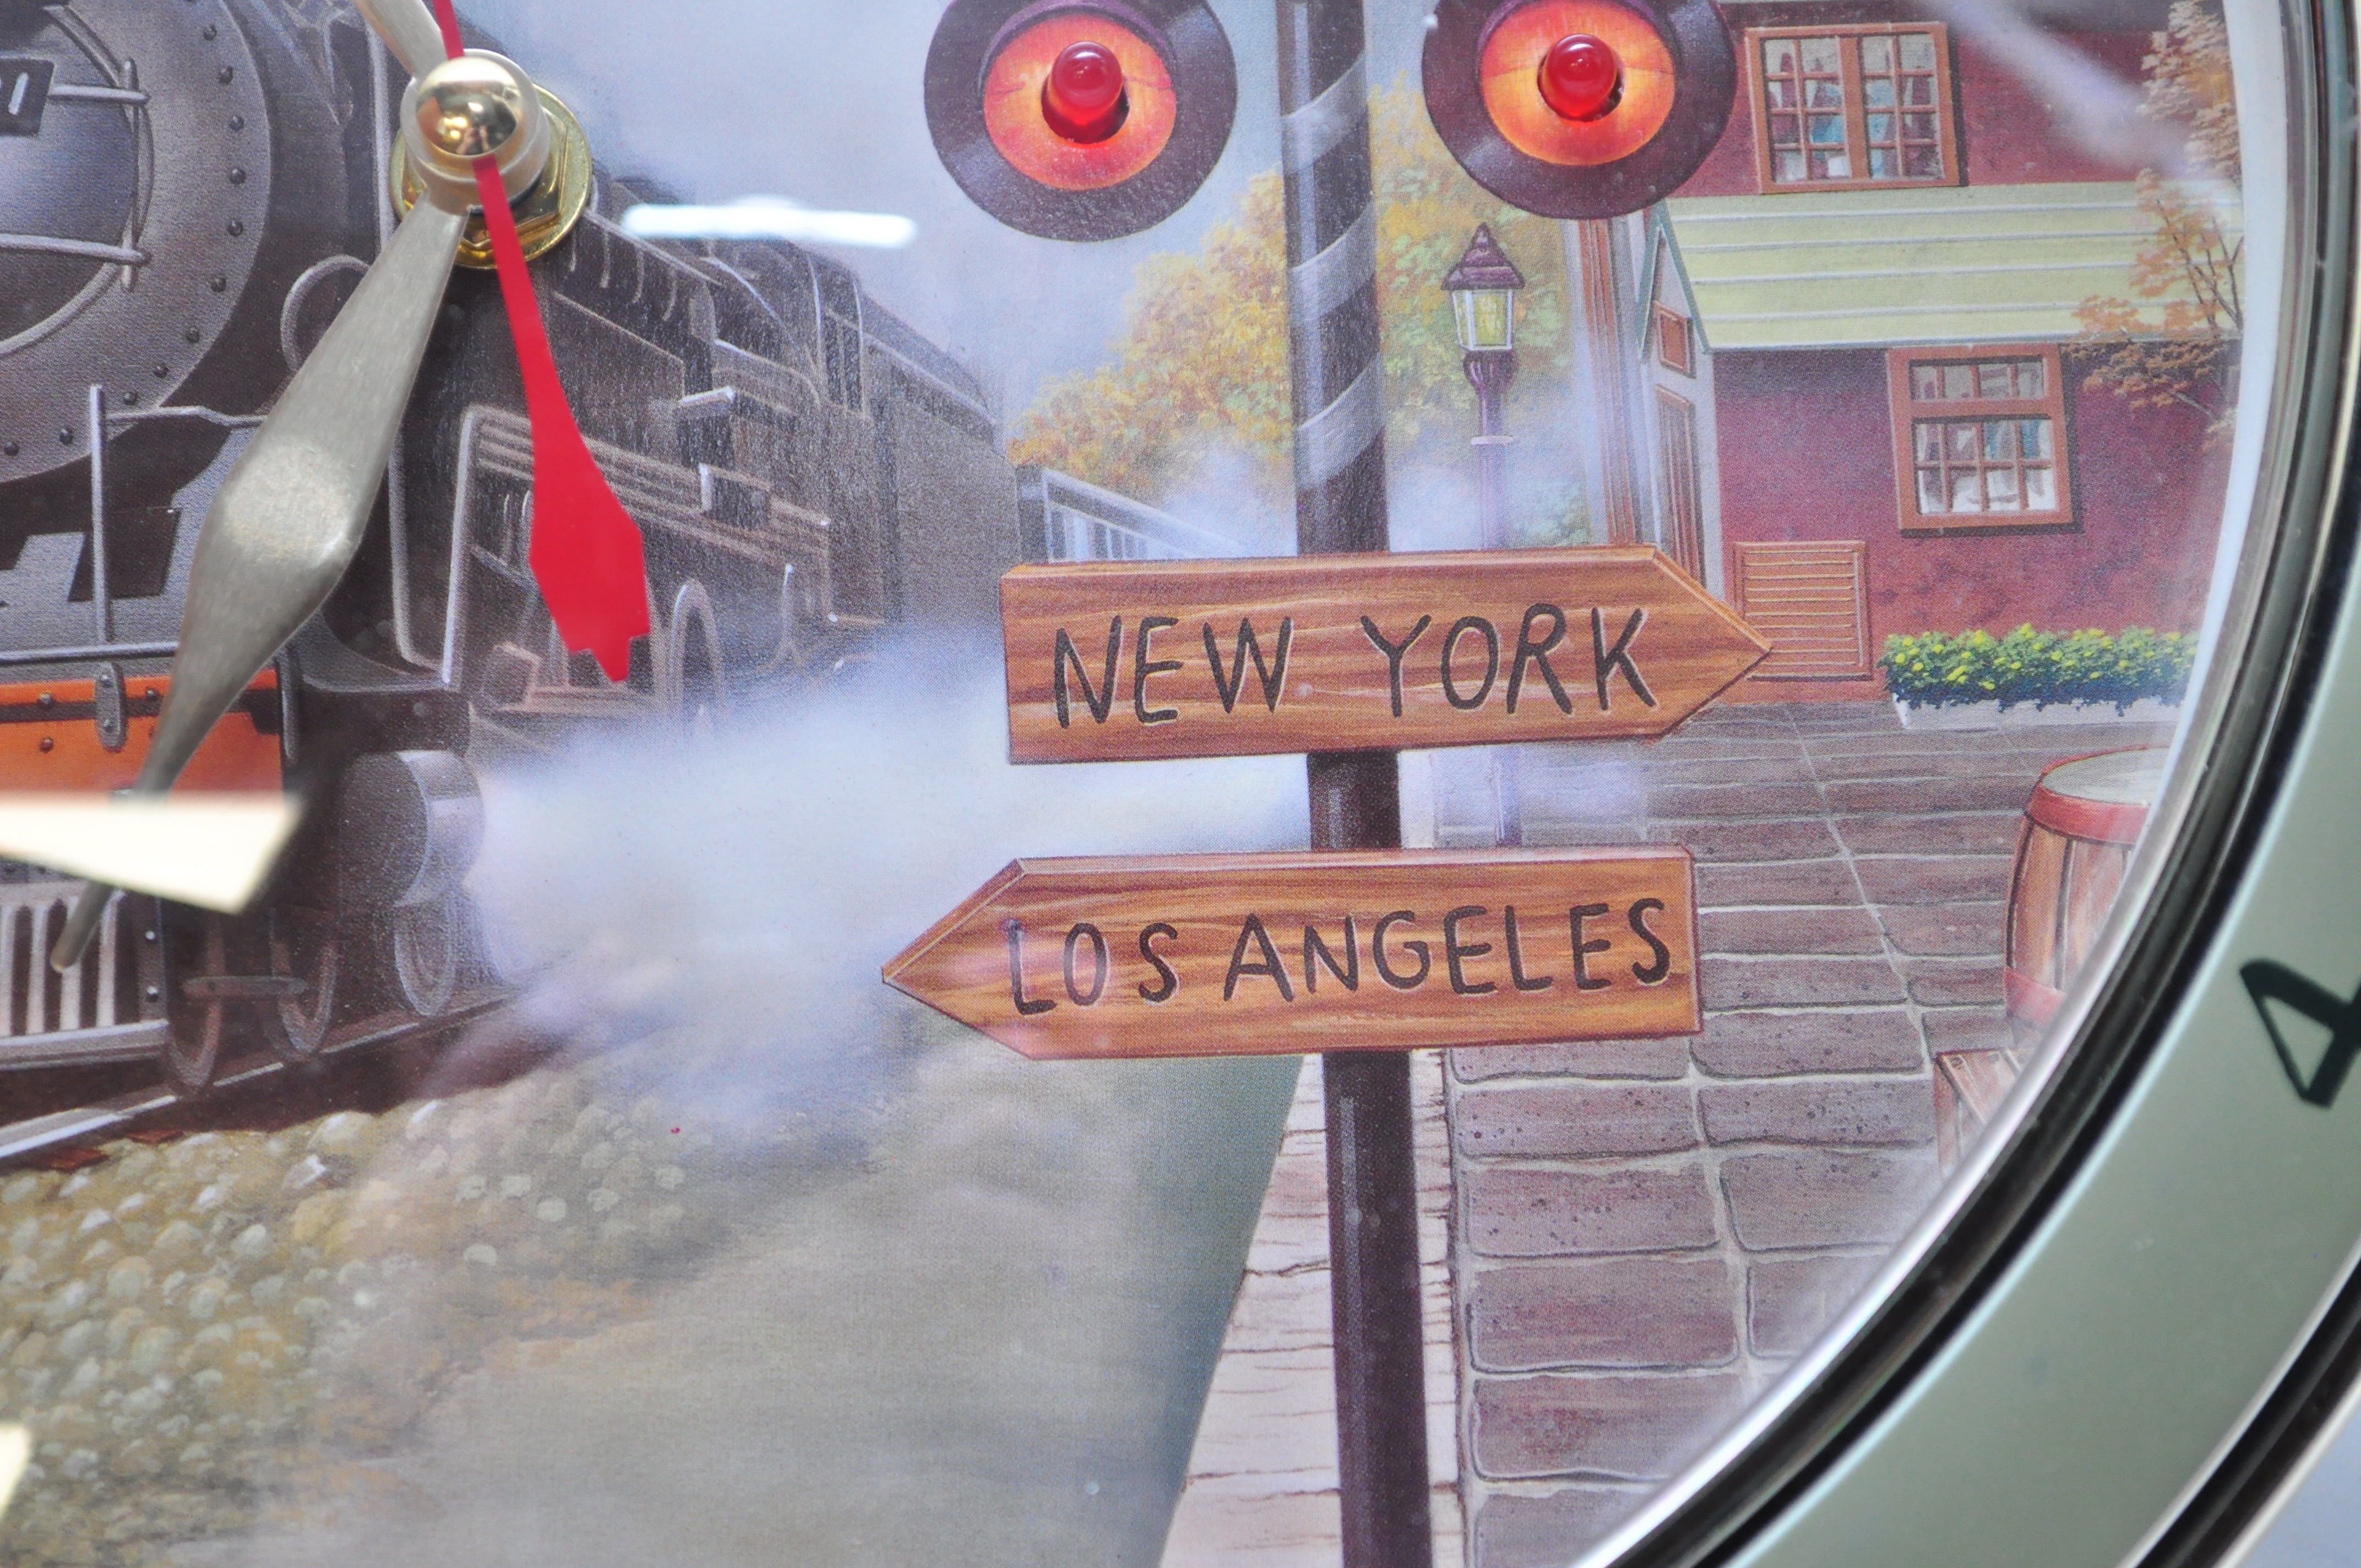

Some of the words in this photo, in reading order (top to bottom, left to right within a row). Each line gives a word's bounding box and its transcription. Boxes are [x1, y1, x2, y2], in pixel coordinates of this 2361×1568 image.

[0, 72, 29, 116] 1
[1053, 614, 1295, 728] NEW
[1359, 602, 1660, 718] YORK
[1003, 917, 1180, 1016] LOS
[1222, 897, 1672, 1003] ANGELES
[2239, 958, 2361, 1109] 4
